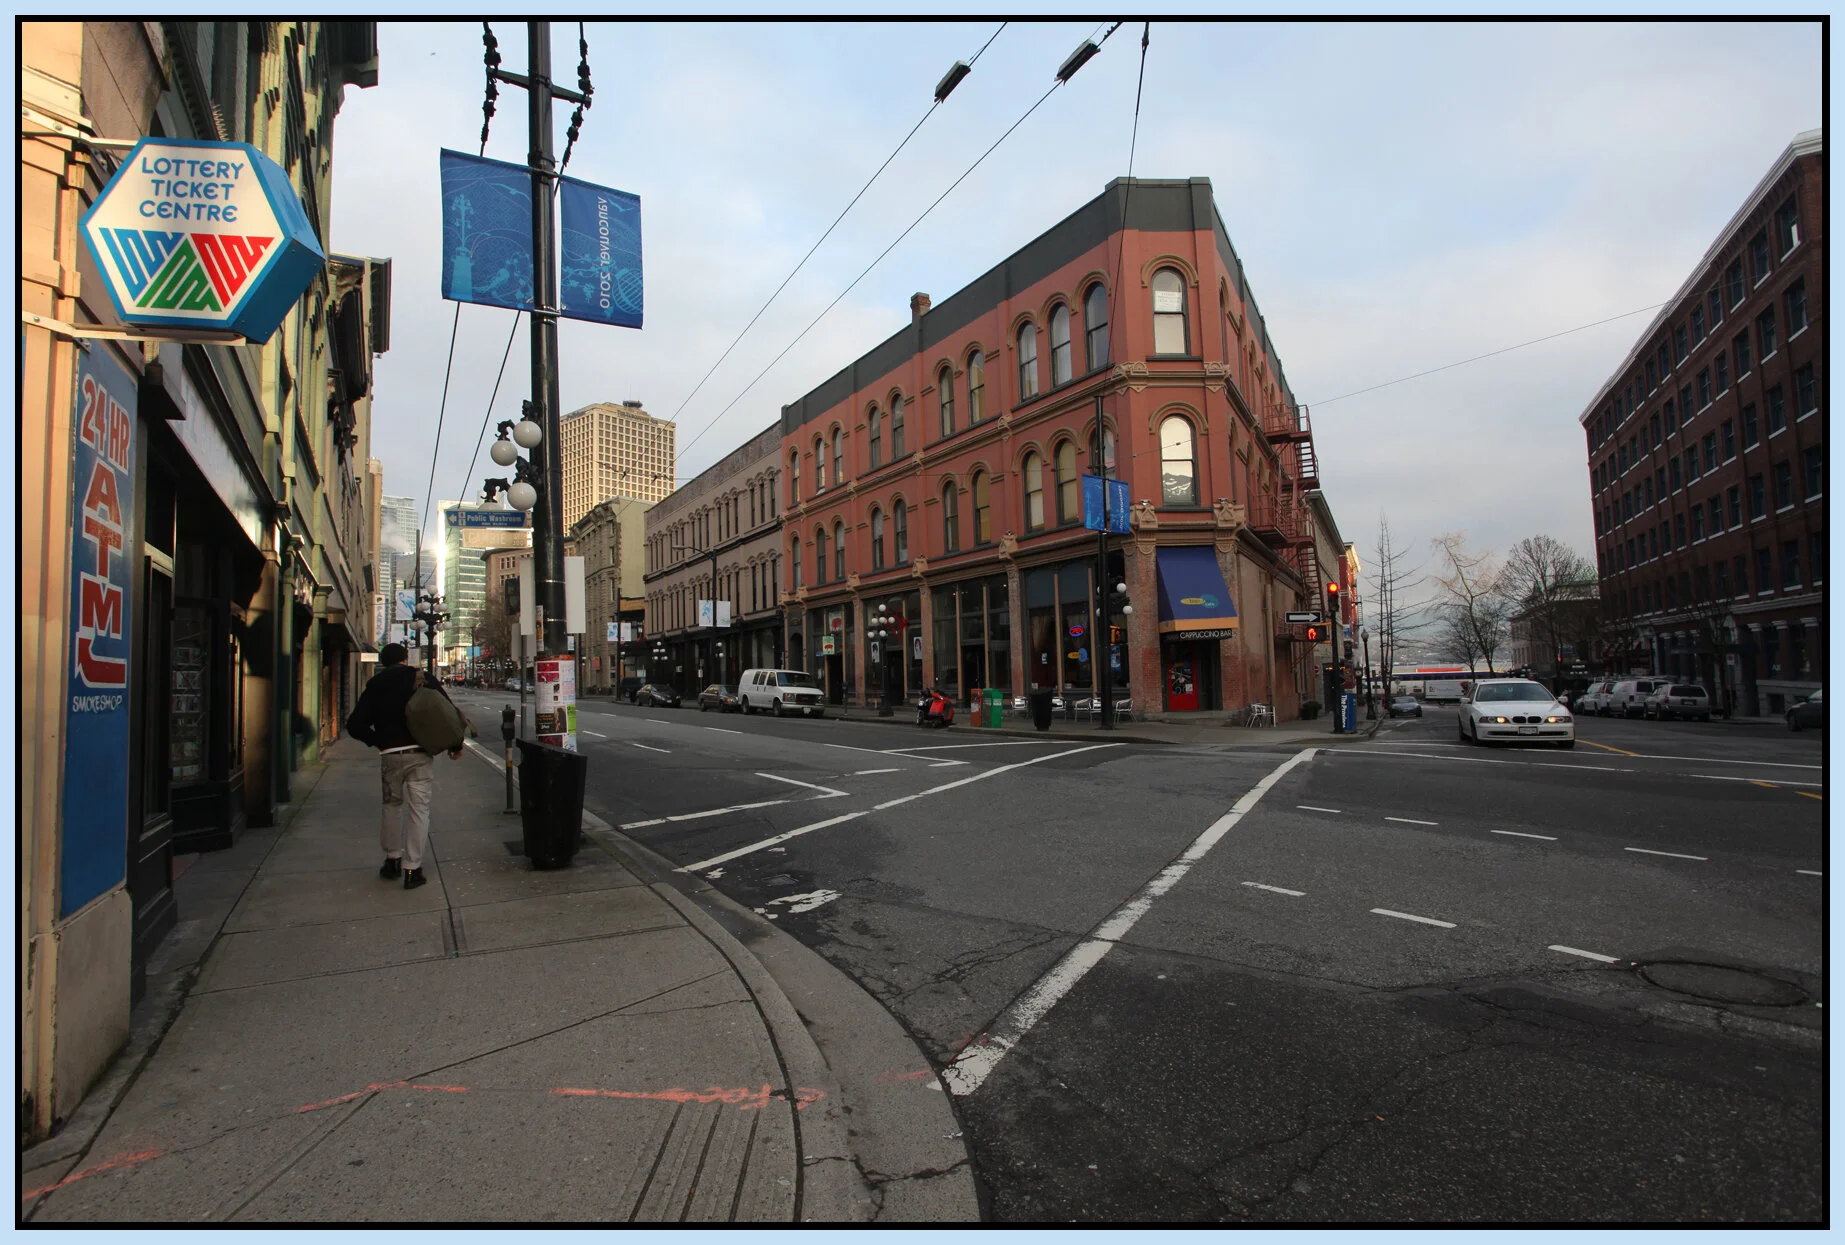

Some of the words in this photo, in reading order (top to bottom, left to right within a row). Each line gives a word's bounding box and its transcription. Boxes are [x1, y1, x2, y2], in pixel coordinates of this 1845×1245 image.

[142, 157, 244, 179] LOTTERY
[151, 179, 235, 201] TICKET
[139, 200, 238, 222] CENTRE
[80, 373, 107, 456] 24
[107, 399, 131, 475] HR
[467, 514, 487, 522] Public
[80, 457, 123, 639] ATM
[1179, 629, 1220, 640] CAPPUCCINO
[1220, 629, 1232, 637] BAR
